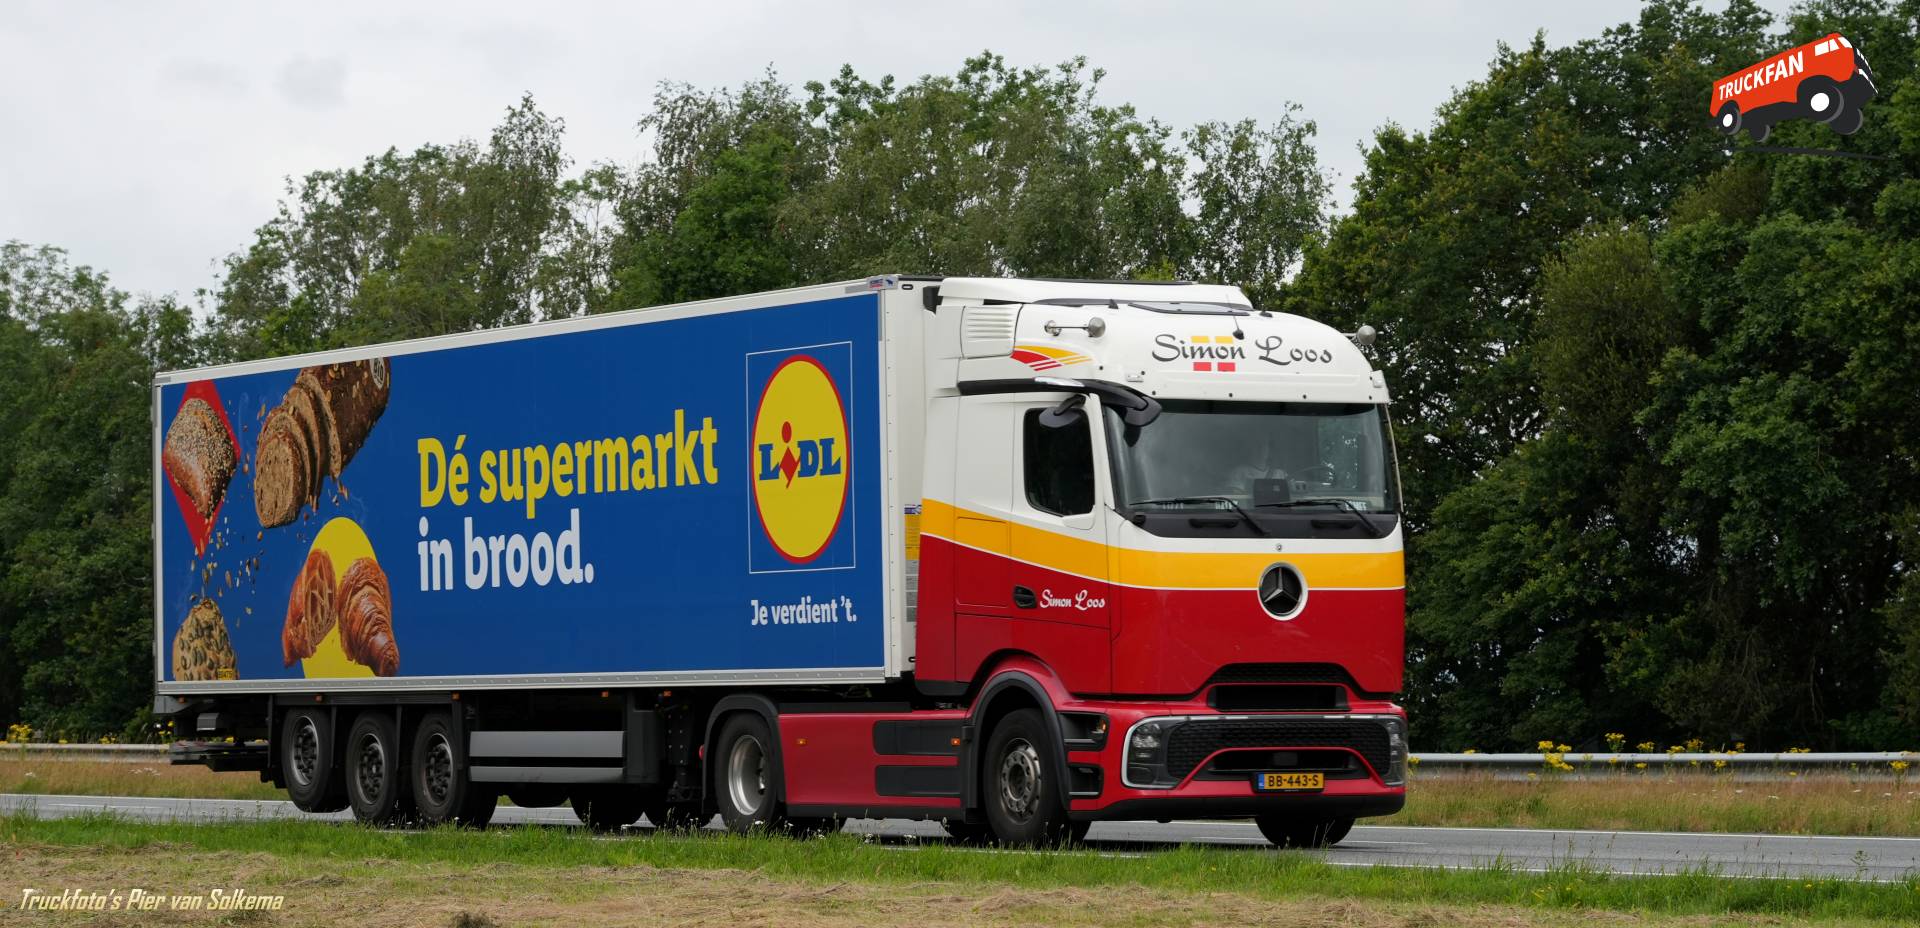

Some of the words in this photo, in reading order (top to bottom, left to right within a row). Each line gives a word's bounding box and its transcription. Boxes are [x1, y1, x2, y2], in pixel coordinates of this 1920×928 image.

[1152, 333, 1246, 362] Simon
[1255, 335, 1332, 366] Loos
[417, 434, 470, 507] Dé
[479, 409, 718, 519] supermarkt
[418, 516, 454, 591] in
[464, 508, 594, 590] brood.
[751, 599, 768, 625] Je
[771, 595, 838, 624] verdient
[1040, 589, 1072, 608] Simon
[1075, 590, 1106, 611] Loos
[1268, 774, 1319, 787] BB-443-S
